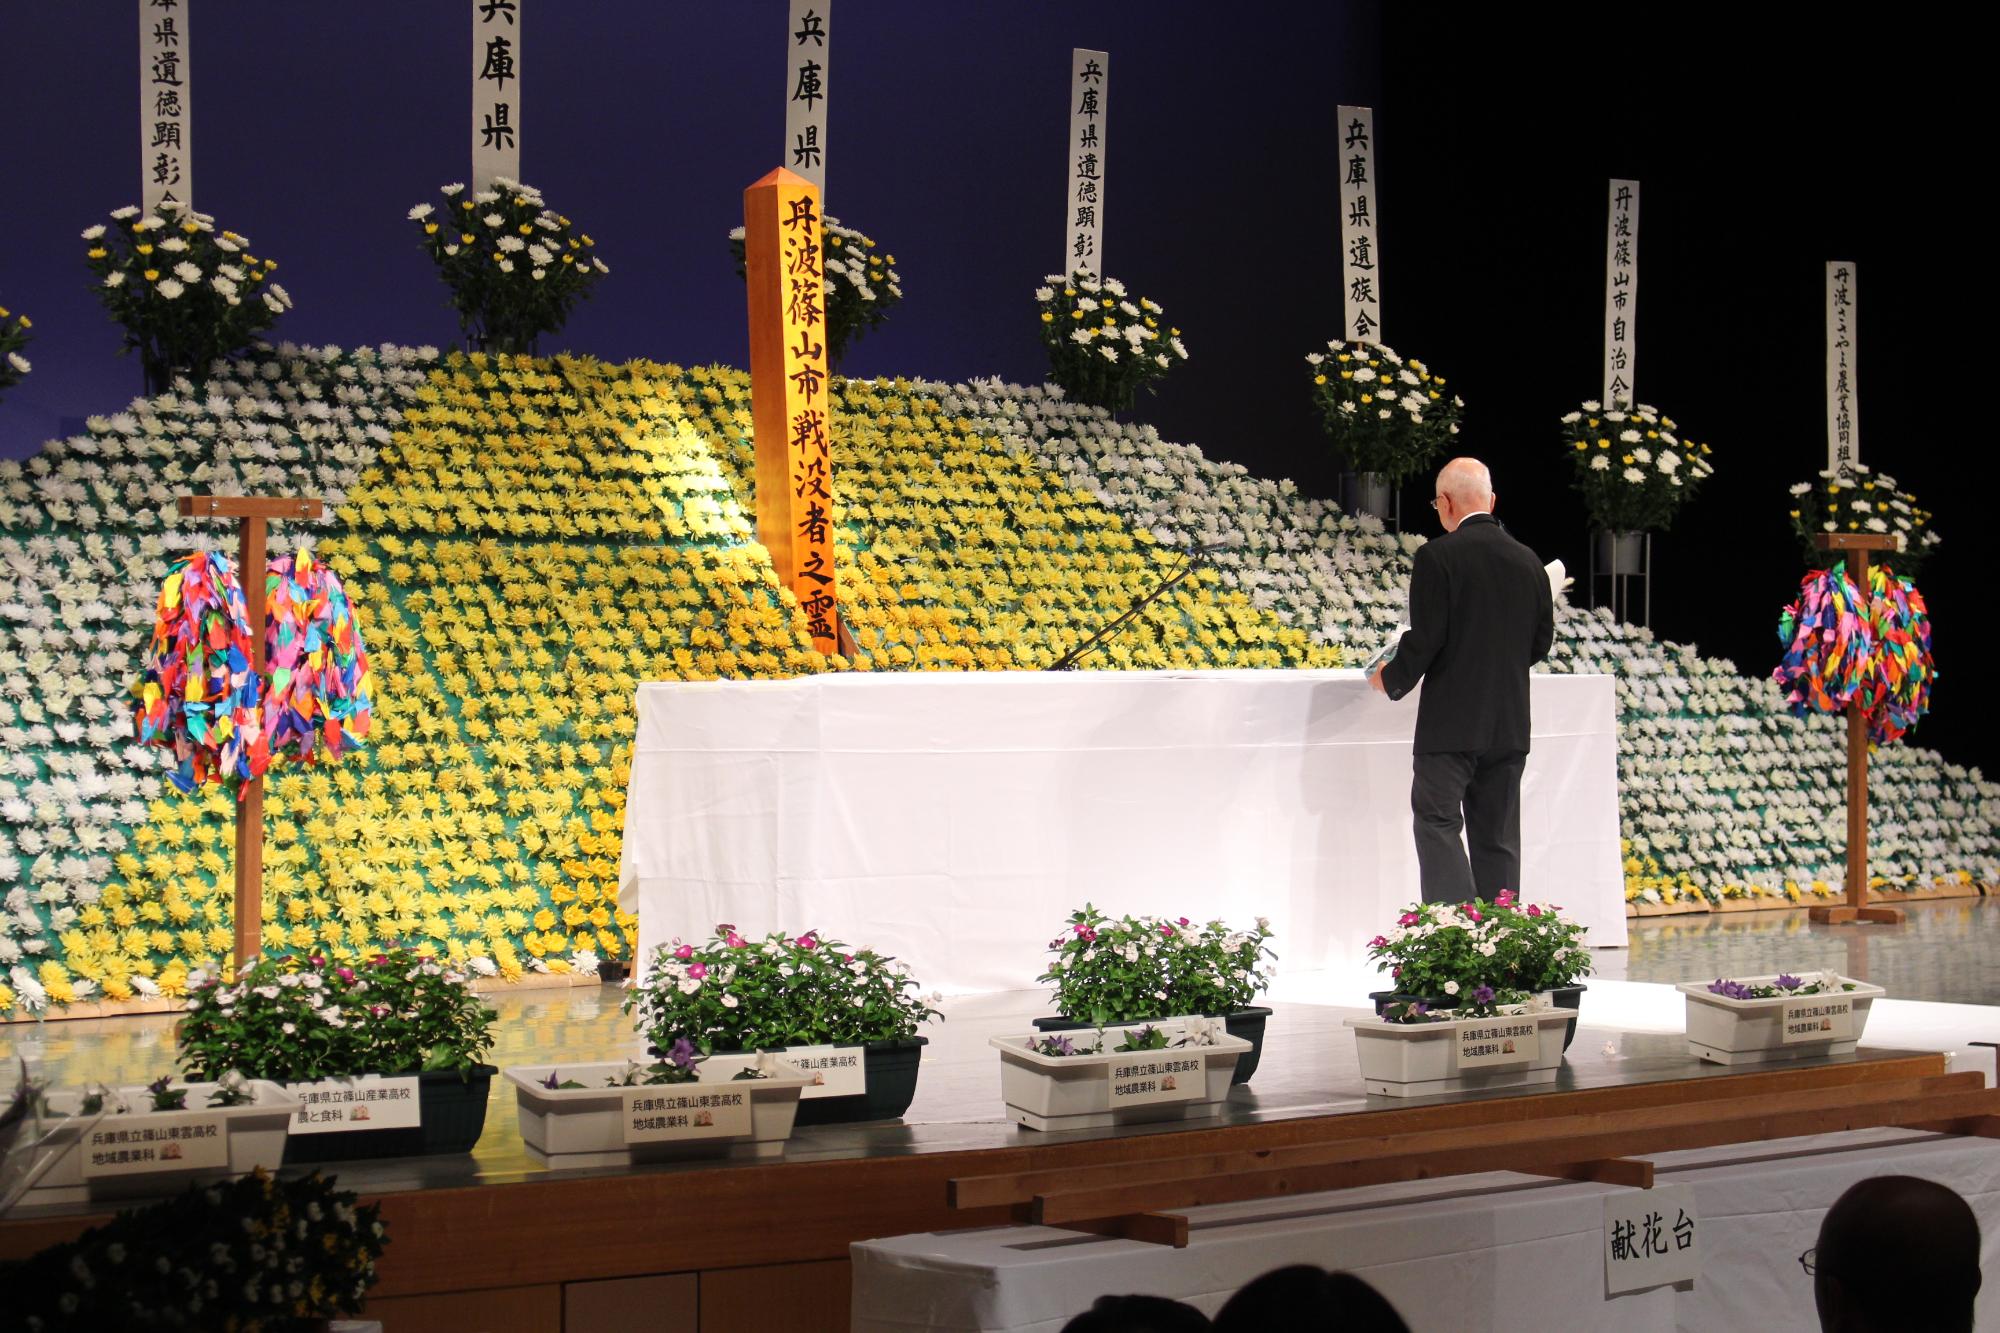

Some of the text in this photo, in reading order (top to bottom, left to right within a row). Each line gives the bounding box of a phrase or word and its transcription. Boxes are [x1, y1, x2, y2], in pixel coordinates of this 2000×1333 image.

[792, 9, 826, 169] 兵庫県
[1345, 118, 1378, 336] 兵庫県遺族会
[783, 195, 836, 641] 丹波篠山市戦没者之霊
[1462, 1024, 1534, 1042] 兵庫県立篠山東雲高校
[1463, 1044, 1500, 1057] 地域農業科
[1115, 1060, 1199, 1079] 兵庫県立篠山東雲高校
[1115, 1080, 1156, 1096] 地域農業科
[632, 1093, 743, 1112] 兵庫県立篠山東雲高校
[297, 1109, 343, 1124] 農と食科
[633, 1115, 689, 1130] 地域農業科
[91, 1124, 217, 1146] 兵庫県立篠山東雲高校
[92, 1147, 155, 1166] 地域農業科
[1610, 1207, 1694, 1261] 献花台
